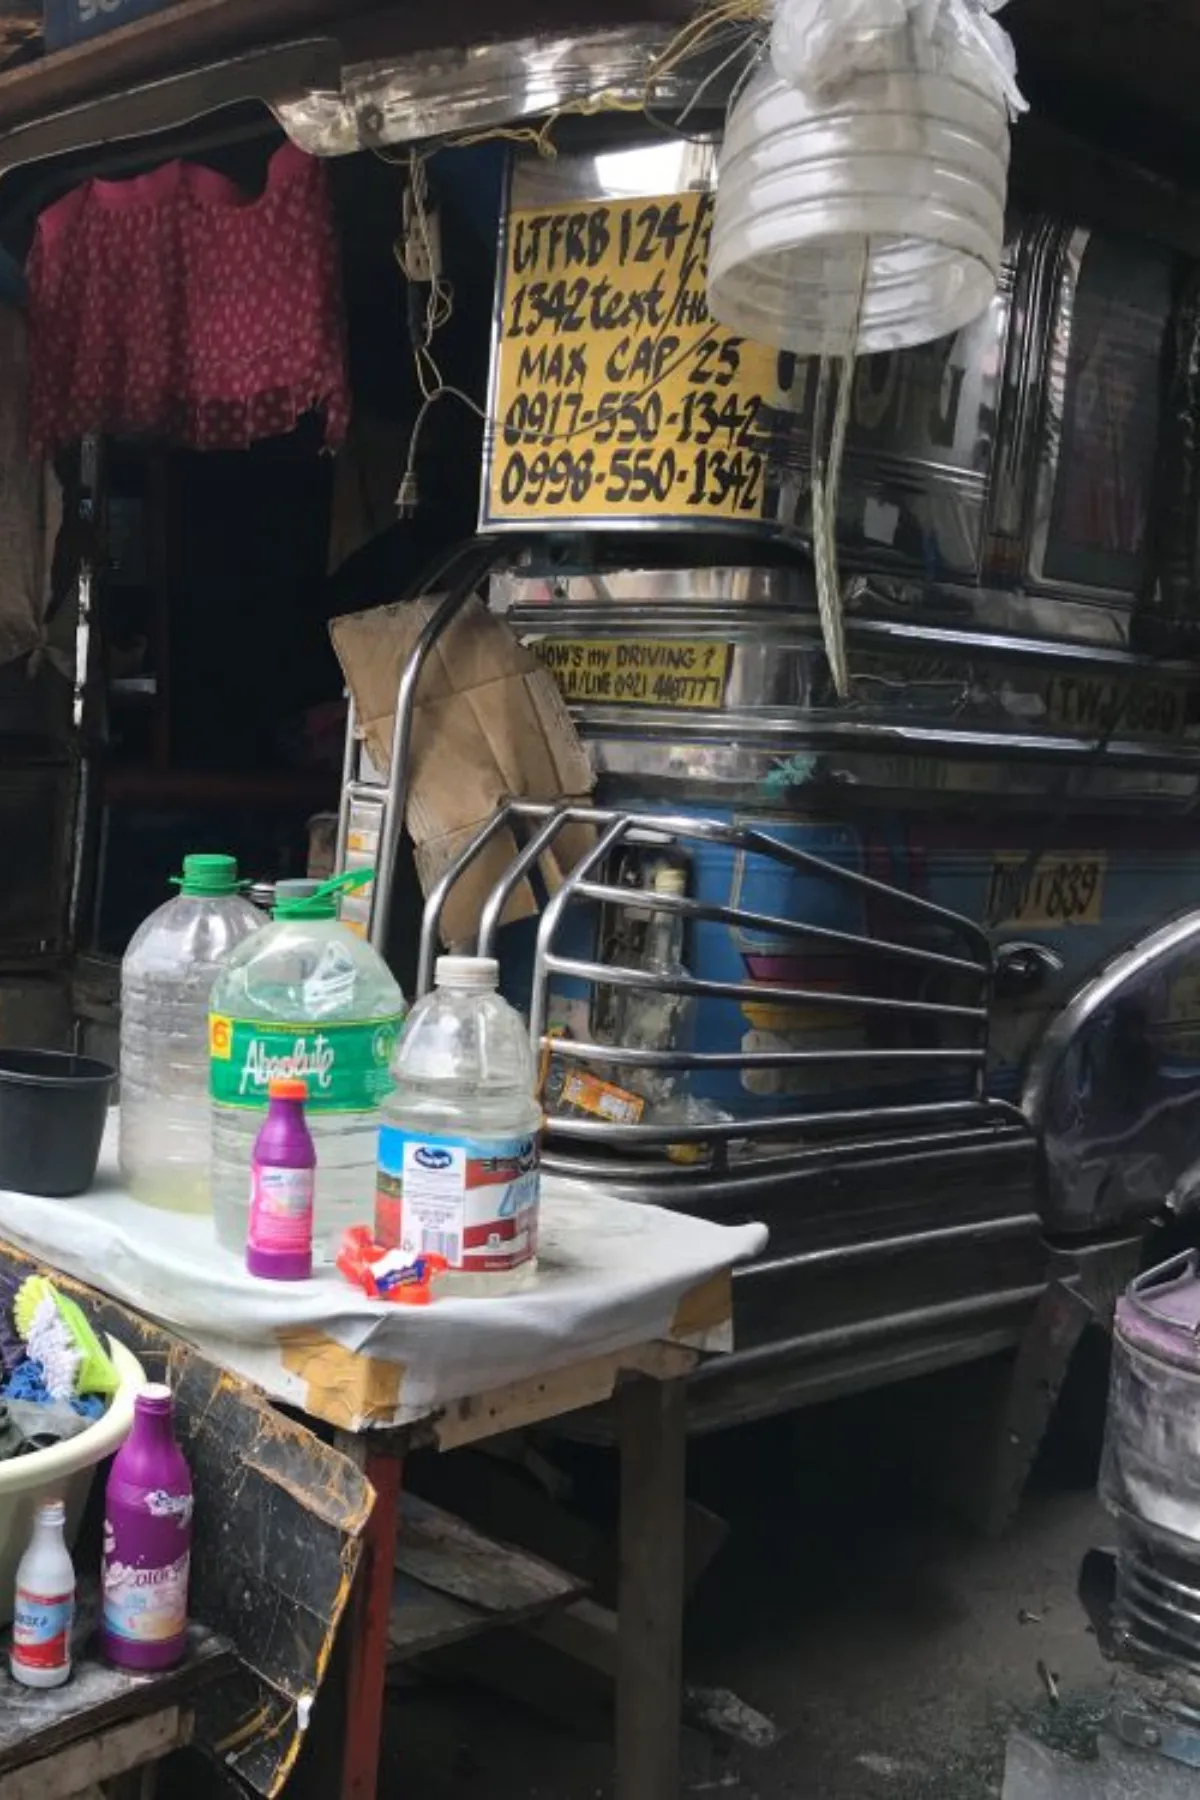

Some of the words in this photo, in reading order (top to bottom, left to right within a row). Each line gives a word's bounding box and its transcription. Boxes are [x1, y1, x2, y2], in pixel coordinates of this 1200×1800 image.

[518, 342, 588, 388] MAX
[688, 337, 746, 386] 25
[503, 391, 763, 449] 0917-550-1342
[500, 448, 763, 513] 0998-550-1342
[615, 644, 697, 669] DRIVING
[238, 1033, 335, 1096] Absolute
